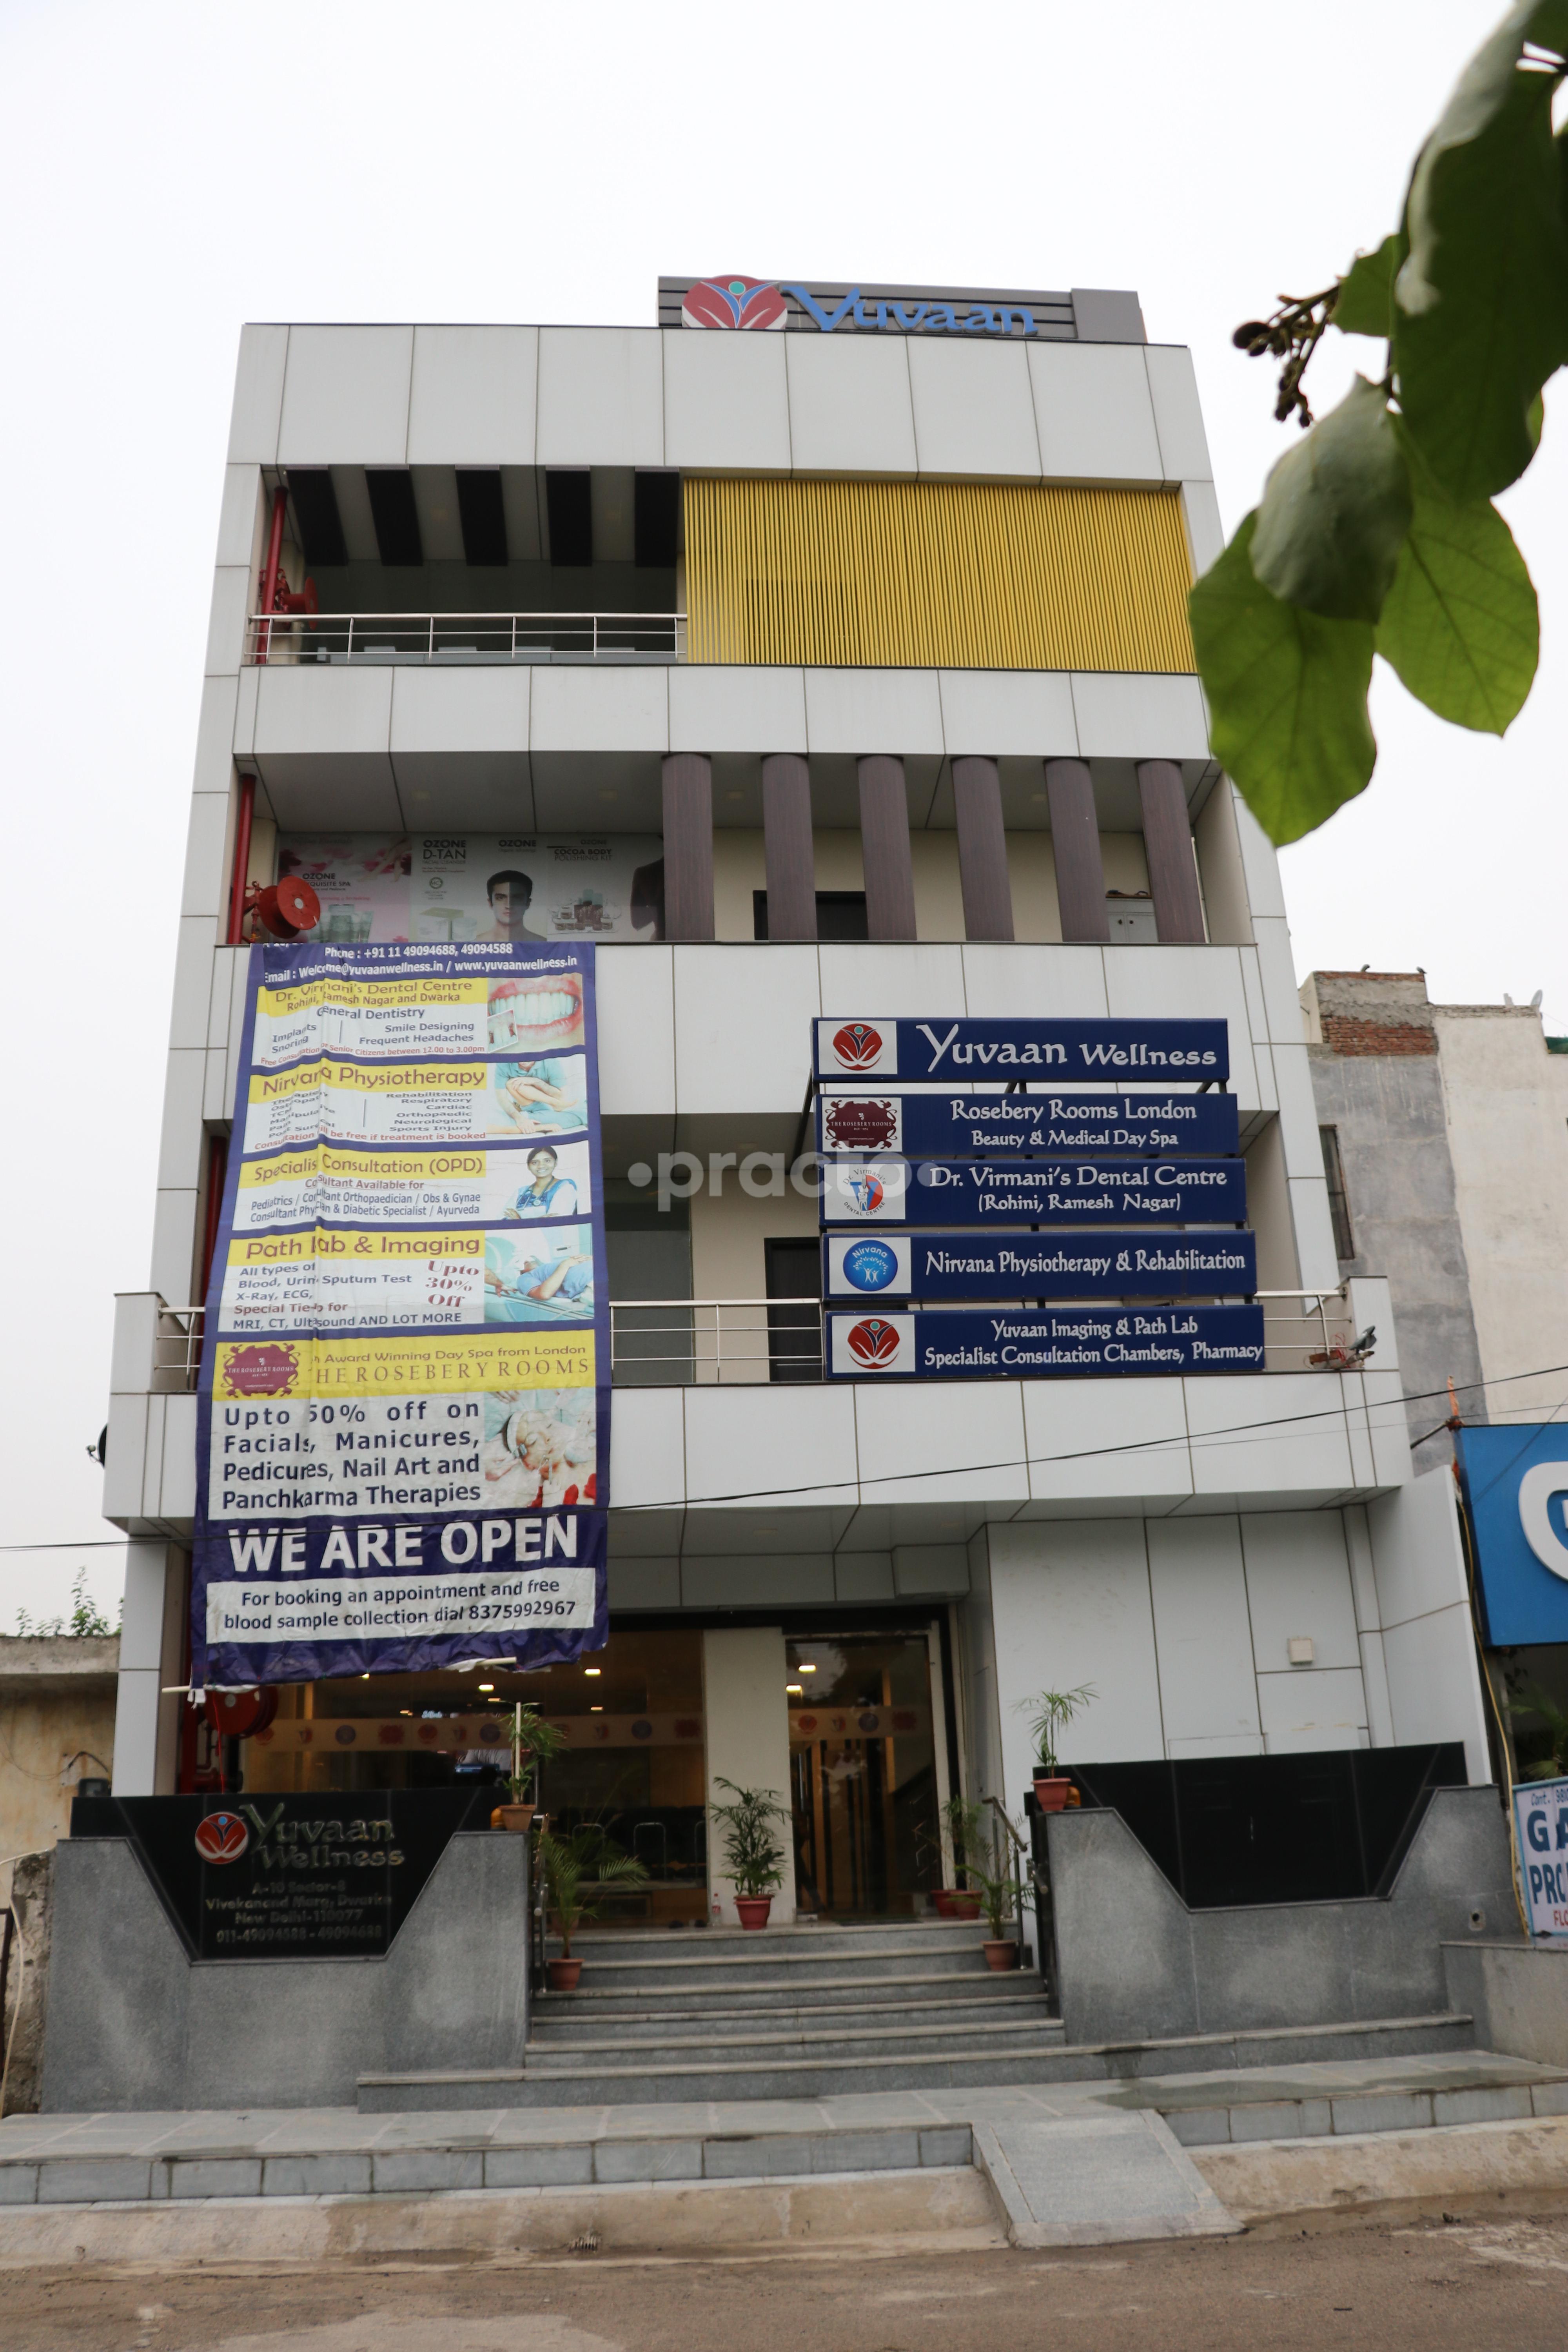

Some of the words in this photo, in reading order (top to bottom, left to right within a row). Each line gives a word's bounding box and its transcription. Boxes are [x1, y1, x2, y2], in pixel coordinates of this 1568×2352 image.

[423, 849, 466, 859] D-TAN
[364, 947, 385, 958] +91
[403, 944, 458, 956] 49094688,
[461, 943, 513, 955] 49094588
[454, 955, 577, 972] www.yuvaanwellness.in
[276, 991, 296, 1002] Dr.
[368, 983, 417, 994] Dental
[423, 982, 472, 991] Centre
[363, 995, 394, 1006] Nagar
[421, 993, 459, 1002] Dwarka
[365, 1008, 425, 1019] Dentistry
[272, 1024, 316, 1042] Implants
[385, 1023, 416, 1033] Smile
[419, 1022, 474, 1032] Designing
[272, 1035, 308, 1053] Snoring
[359, 1035, 410, 1045] Frequent
[413, 1033, 474, 1042] Headaches
[915, 1024, 1067, 1073] Yuvaan
[1079, 1044, 1217, 1065] Wellness
[339, 1067, 484, 1088] Physiotherapy
[950, 1099, 1042, 1123] Rosebery
[1049, 1099, 1118, 1120] Rooms
[1124, 1098, 1197, 1119] London
[346, 1131, 367, 1140] free
[971, 1130, 1025, 1149] Beauty
[1048, 1129, 1109, 1145] Medical
[1113, 1129, 1146, 1147] Day
[1150, 1129, 1178, 1148] Spa
[322, 1154, 423, 1173] Consultation
[429, 1158, 482, 1175] (OPD)
[356, 1180, 405, 1190] Available
[929, 1167, 964, 1187] Dr.
[969, 1166, 1071, 1187] Virmani's
[1077, 1167, 1149, 1185] Dental
[1155, 1166, 1227, 1185] Centre
[251, 1196, 292, 1210] Pediatrics
[343, 1192, 412, 1205] Orthopaedician
[453, 1193, 480, 1204] Gynae
[844, 1202, 862, 1216] DENTAL
[866, 1201, 885, 1216] CENTRE
[979, 1194, 1044, 1212] (Rohini,
[1048, 1194, 1114, 1210] Ramesh
[1123, 1193, 1181, 1211] Nagar)
[250, 1207, 296, 1222] Consultant
[343, 1205, 380, 1216] Diabetic
[383, 1205, 426, 1218] Specialist
[437, 1205, 479, 1217] Ayurveda
[246, 1238, 301, 1259] Path
[381, 1236, 479, 1255] Imaging
[852, 1247, 887, 1259] Nirvana
[262, 1265, 298, 1276] types
[427, 1260, 479, 1276] Upto
[926, 1251, 995, 1276] Nirvana
[998, 1251, 1111, 1276] Physiotherapy
[1136, 1249, 1245, 1271] Rehabilitation
[238, 1278, 281, 1288] Blood,
[322, 1275, 376, 1285] Sputum
[425, 1277, 472, 1292] 30%
[236, 1291, 278, 1301] X-Ray,
[283, 1290, 313, 1299] ECG,
[428, 1294, 465, 1308] Off
[234, 1304, 284, 1316] Special
[233, 1319, 264, 1330] MRI,
[269, 1318, 289, 1329] CT,
[359, 1316, 388, 1325] AND
[392, 1314, 418, 1324] LOT
[422, 1313, 461, 1323] MORE
[991, 1319, 1048, 1341] Yuvaan
[1051, 1318, 1111, 1339] Imaging
[1134, 1317, 1167, 1335] Path
[1171, 1316, 1198, 1334] Lab
[324, 1354, 370, 1363] Award
[375, 1352, 430, 1361] Winning
[436, 1350, 463, 1360] Day
[498, 1347, 530, 1357] from
[535, 1345, 585, 1355] London
[925, 1346, 998, 1369] Specialist
[1001, 1345, 1100, 1365] Consultation
[1103, 1344, 1185, 1364] Chambers,
[1192, 1342, 1263, 1362] Pharmacy
[356, 1362, 488, 1383] ROSEBERY
[498, 1358, 588, 1377] ROOMS
[225, 1407, 290, 1430] Upto
[387, 1401, 426, 1421] off
[336, 1430, 479, 1450] Manicures,
[223, 1461, 333, 1482] Pedicures,
[343, 1457, 385, 1478] Nail
[394, 1457, 430, 1475] Art
[222, 1488, 357, 1509] Panchkarma
[365, 1483, 481, 1506] Therapies
[228, 1528, 307, 1572] WE
[320, 1523, 423, 1569] ARE
[441, 1514, 577, 1564] OPEN
[276, 1588, 341, 1606] booking
[374, 1583, 486, 1604] appointment
[527, 1579, 559, 1592] free
[225, 1614, 271, 1629] blood
[277, 1612, 338, 1630] sample
[344, 1609, 428, 1626] collection
[434, 1606, 464, 1622] dial
[468, 1601, 575, 1619] 8375992967
[238, 1802, 395, 1854] Yuvaan
[257, 1845, 406, 1869] Wellness
